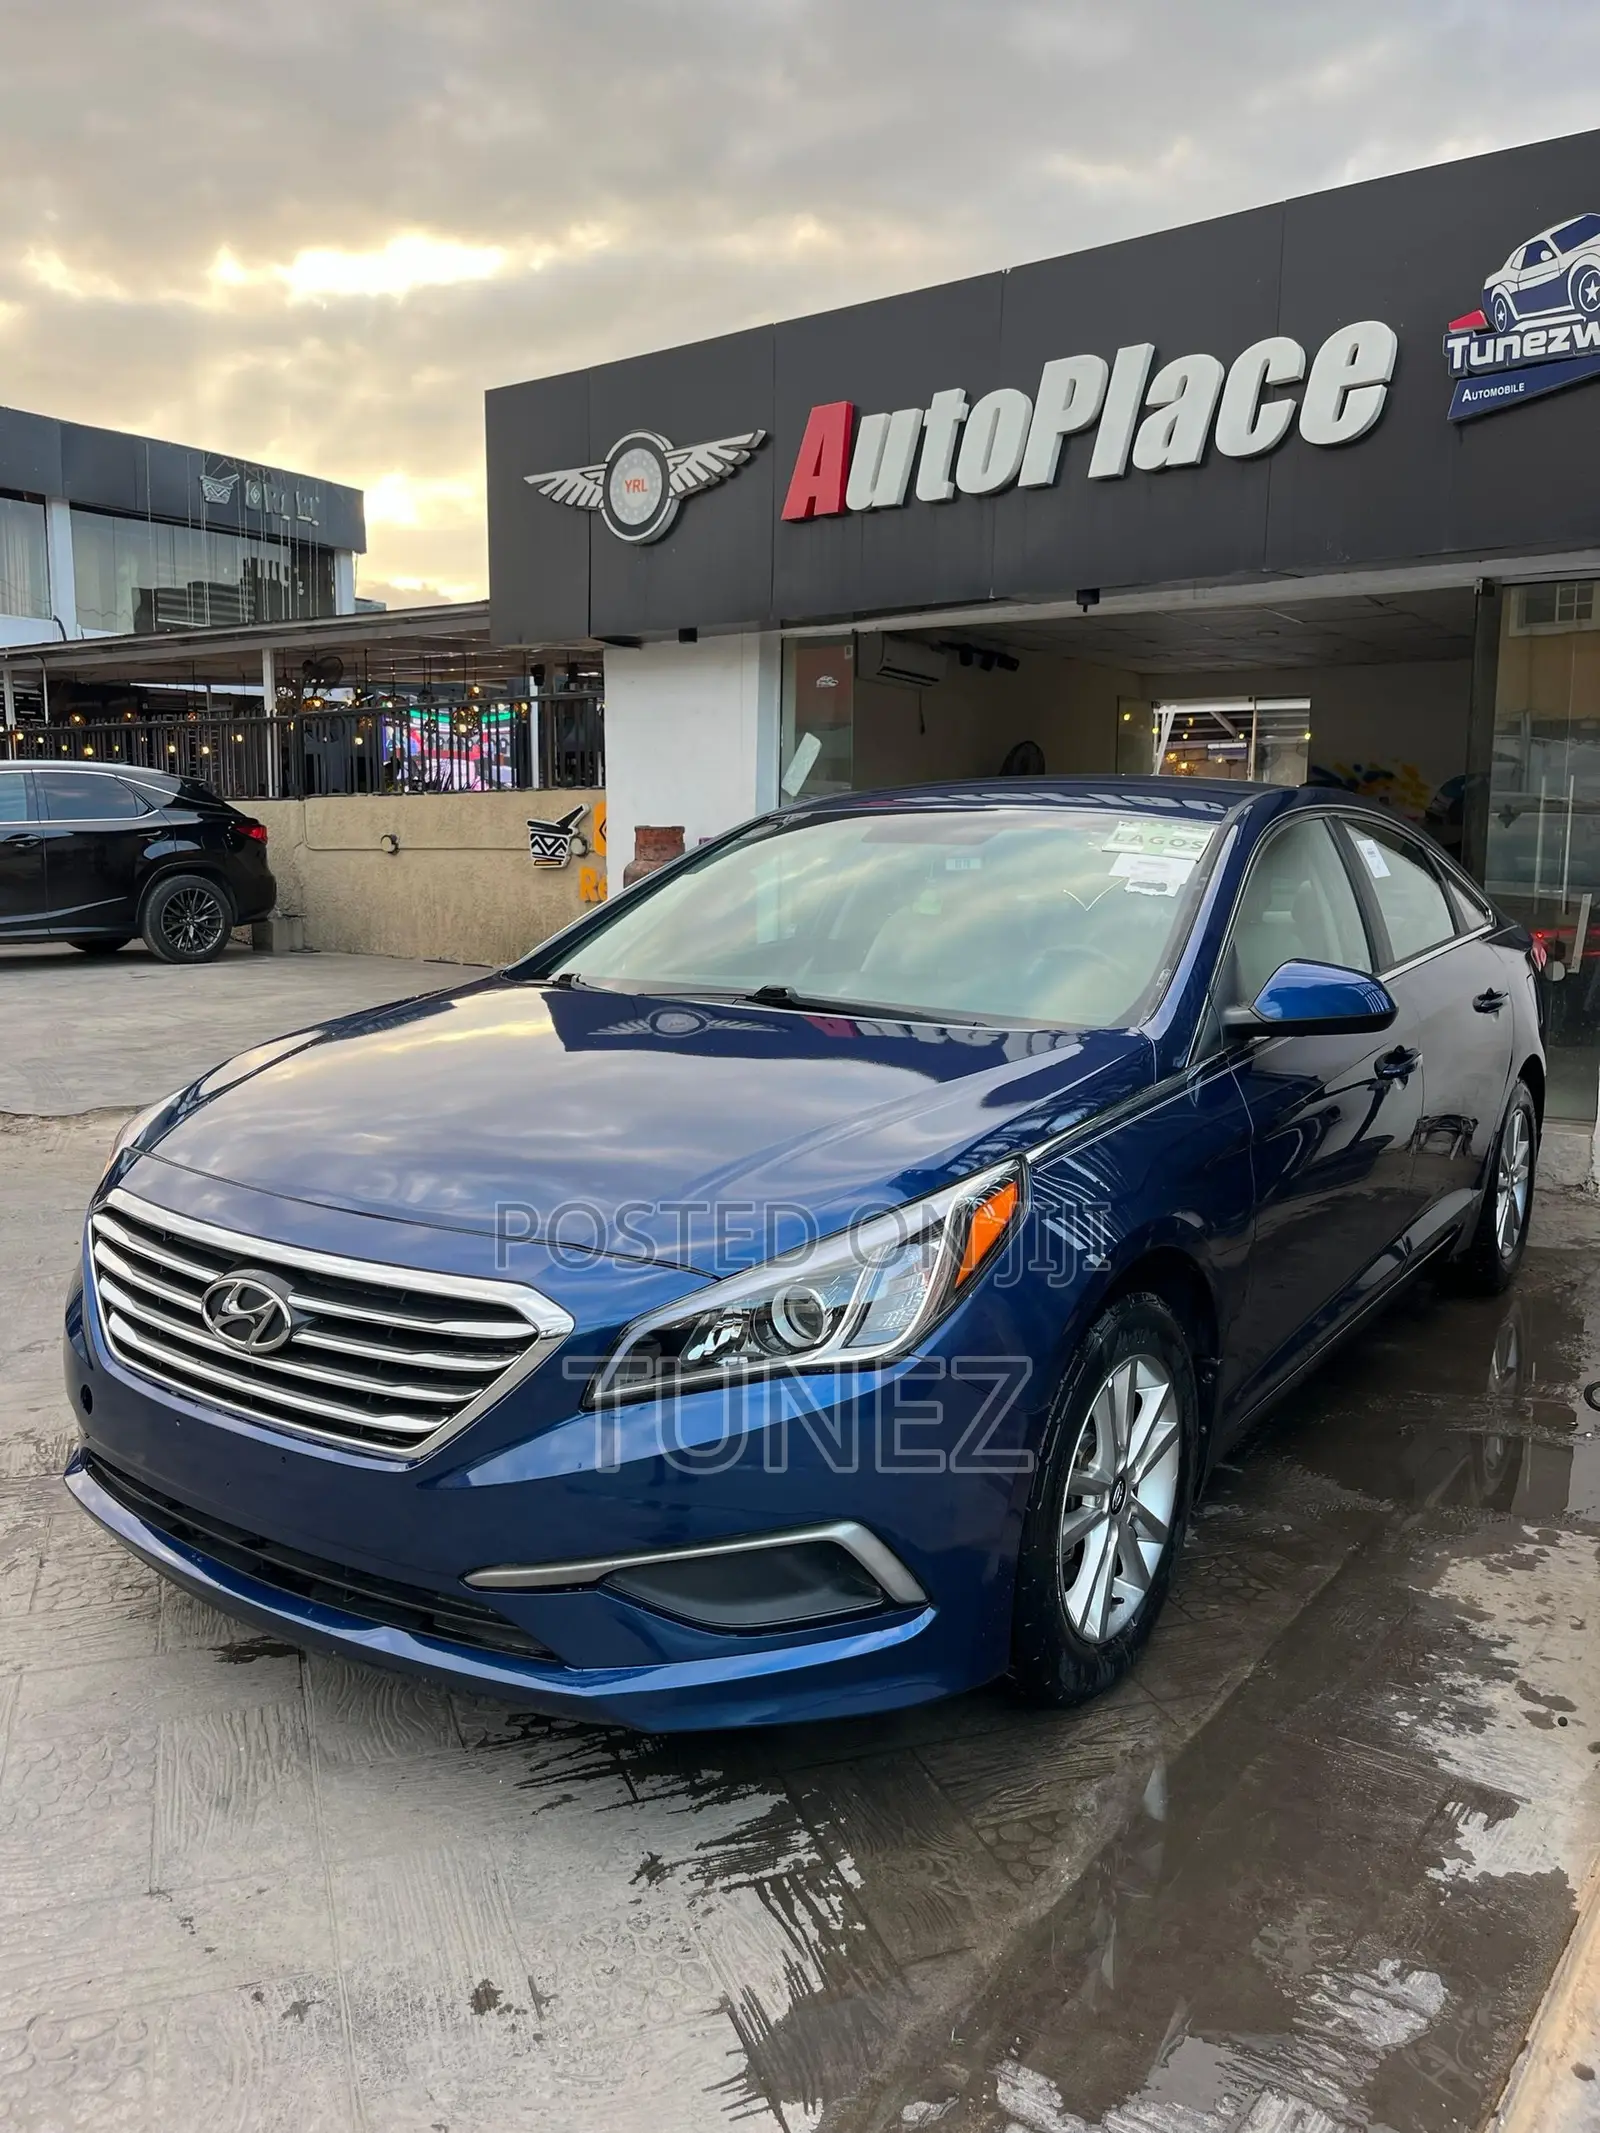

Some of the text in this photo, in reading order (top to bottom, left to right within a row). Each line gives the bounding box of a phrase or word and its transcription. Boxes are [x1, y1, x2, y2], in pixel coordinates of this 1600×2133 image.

[780, 320, 1399, 522] AutoPlace
[624, 478, 648, 495] YRL
[1113, 832, 1205, 850] LAGOS
